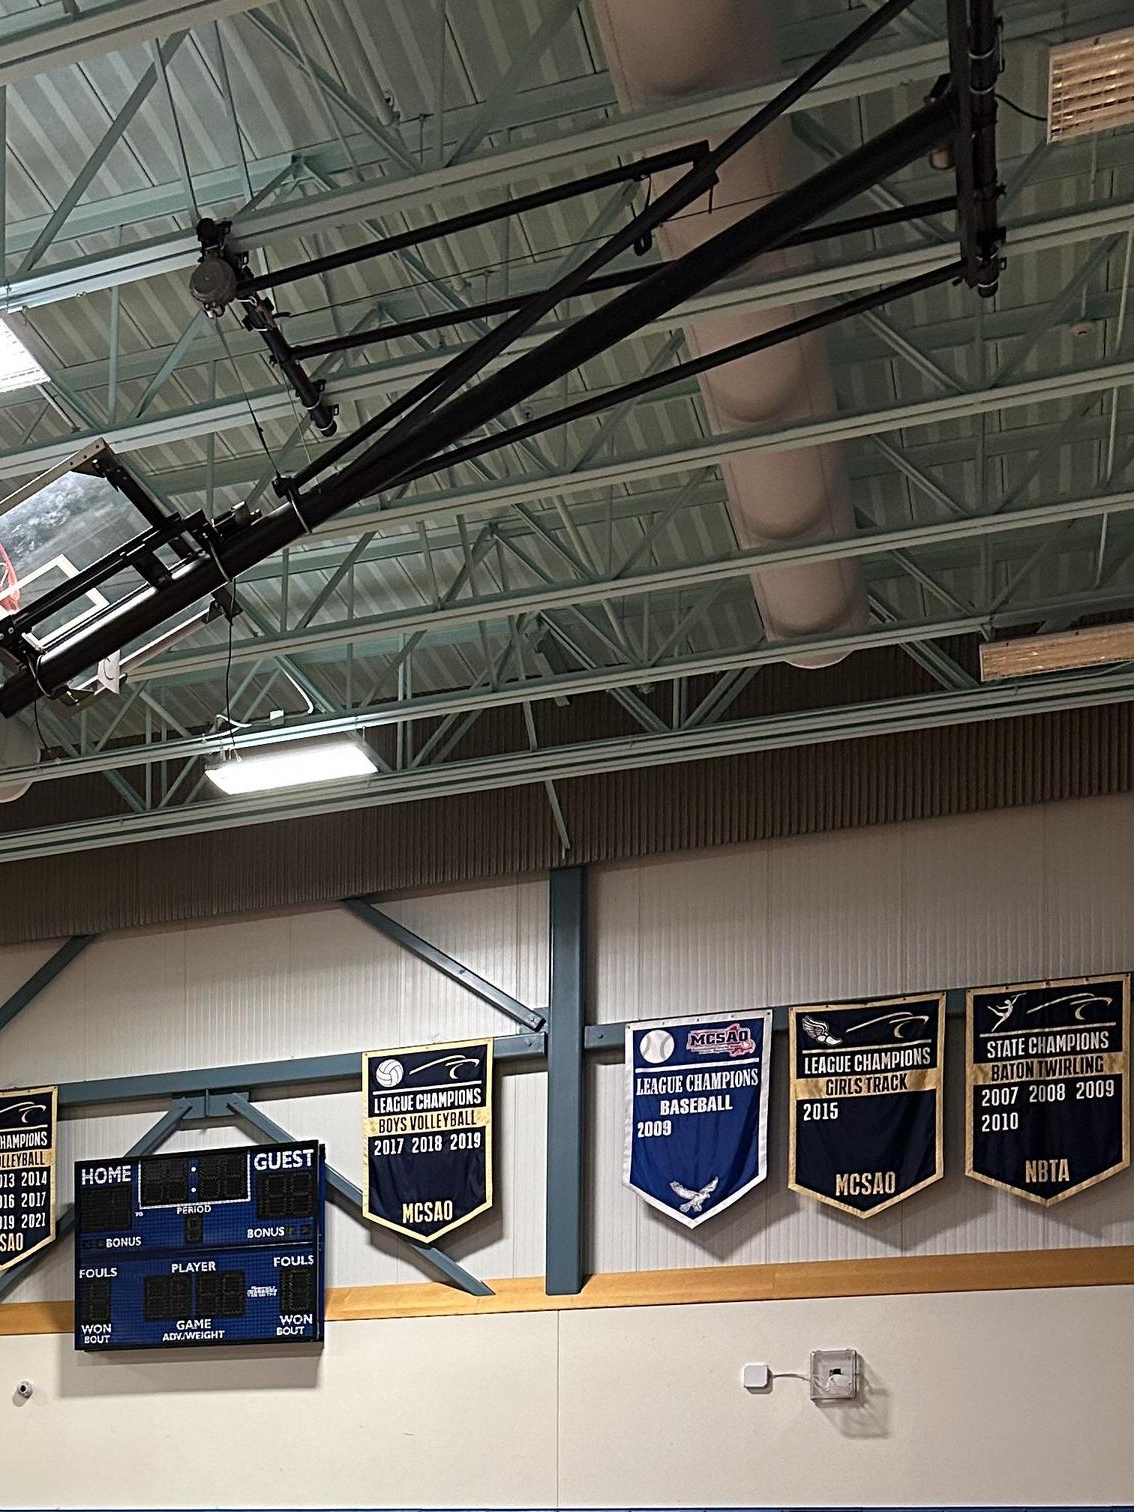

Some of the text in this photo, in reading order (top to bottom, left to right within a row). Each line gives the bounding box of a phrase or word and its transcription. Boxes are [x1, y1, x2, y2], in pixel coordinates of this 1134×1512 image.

[690, 1030, 748, 1046] MCSAO
[987, 1031, 1109, 1058] STATE CHAMPIONS
[804, 1047, 931, 1075] LEAGUE CHAMPIONS
[991, 1055, 1104, 1082] BATON TWIRLING
[636, 1068, 759, 1096] LEAGUE CHAMPIONS
[826, 1073, 908, 1096] GIRLS TRACK
[374, 1087, 482, 1114] LEAGUE CHAMPIONS
[981, 1079, 1115, 1107] 2007 2008 2009
[660, 1095, 733, 1116] BASEBALL
[803, 1102, 839, 1121] 2015
[379, 1109, 477, 1134] BOYS VOLLEYBALL
[637, 1120, 672, 1138] 2009
[981, 1112, 1019, 1132] 2010
[374, 1131, 482, 1156] 2017 2018 2019
[253, 1149, 314, 1171] GUEST
[21, 1171, 47, 1186] 2014
[81, 1165, 132, 1185] HOME
[1025, 1158, 1070, 1183] NBTA
[835, 1171, 896, 1196] MCSAO
[21, 1191, 46, 1207] 2017
[176, 1205, 211, 1215] PERIOD
[402, 1200, 453, 1223] MCSAO
[21, 1212, 46, 1228] 2021
[106, 1237, 142, 1248] BONUS
[247, 1227, 285, 1239] BONUS
[171, 1261, 216, 1273] PLAYER
[273, 1255, 314, 1267] FOULS
[79, 1267, 117, 1279] FOULS
[81, 1323, 112, 1335] WON
[176, 1319, 212, 1330] GAME
[279, 1314, 313, 1325] WON
[84, 1334, 111, 1344] BOUT
[276, 1326, 305, 1336] BOUT
